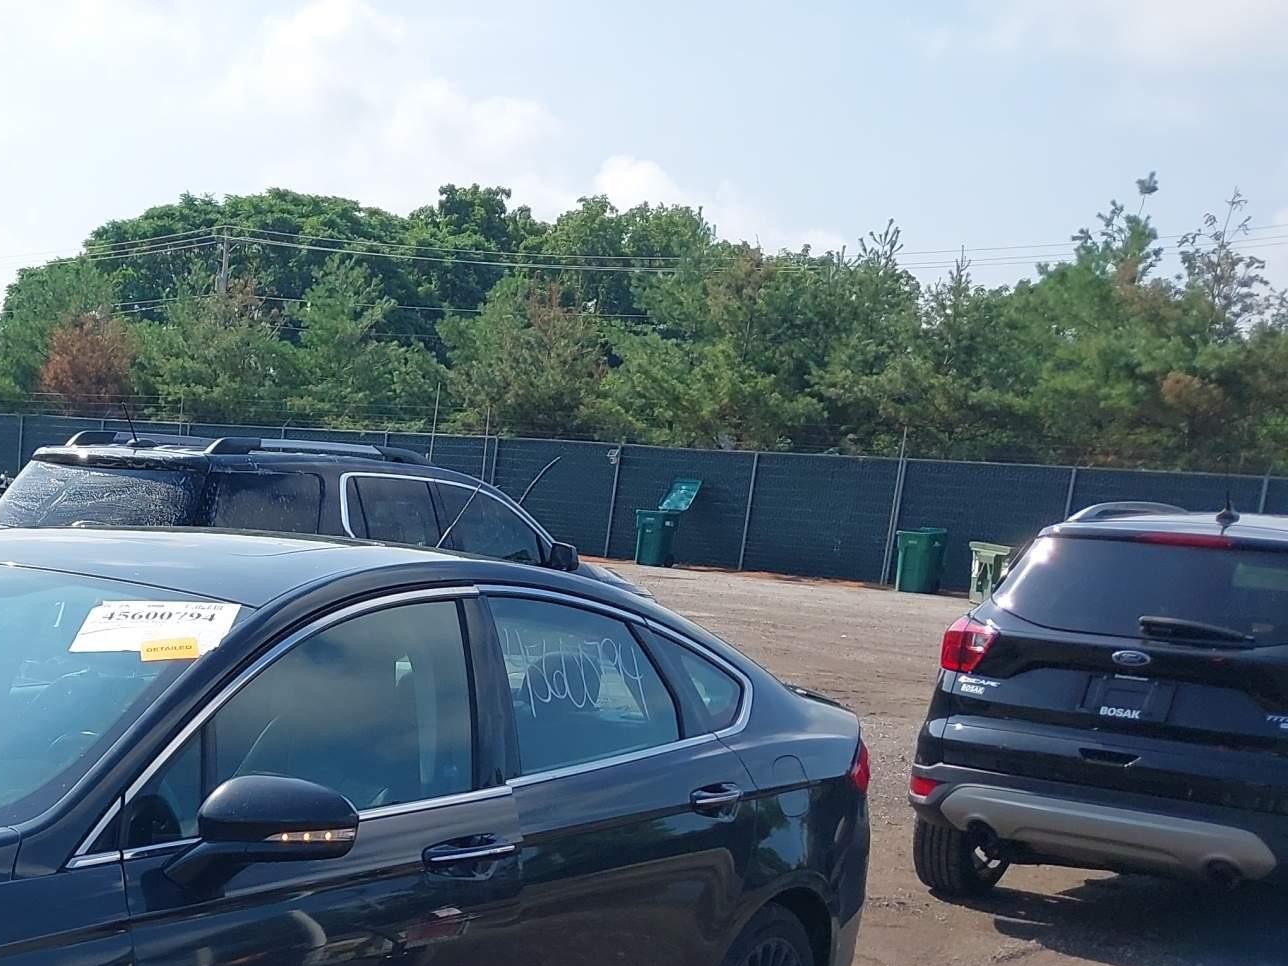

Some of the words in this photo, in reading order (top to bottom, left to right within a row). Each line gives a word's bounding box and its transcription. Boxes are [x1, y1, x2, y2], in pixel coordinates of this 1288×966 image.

[102, 610, 217, 622] 45600794
[146, 645, 193, 653] DETAILED
[1099, 706, 1141, 719] BOSAK
